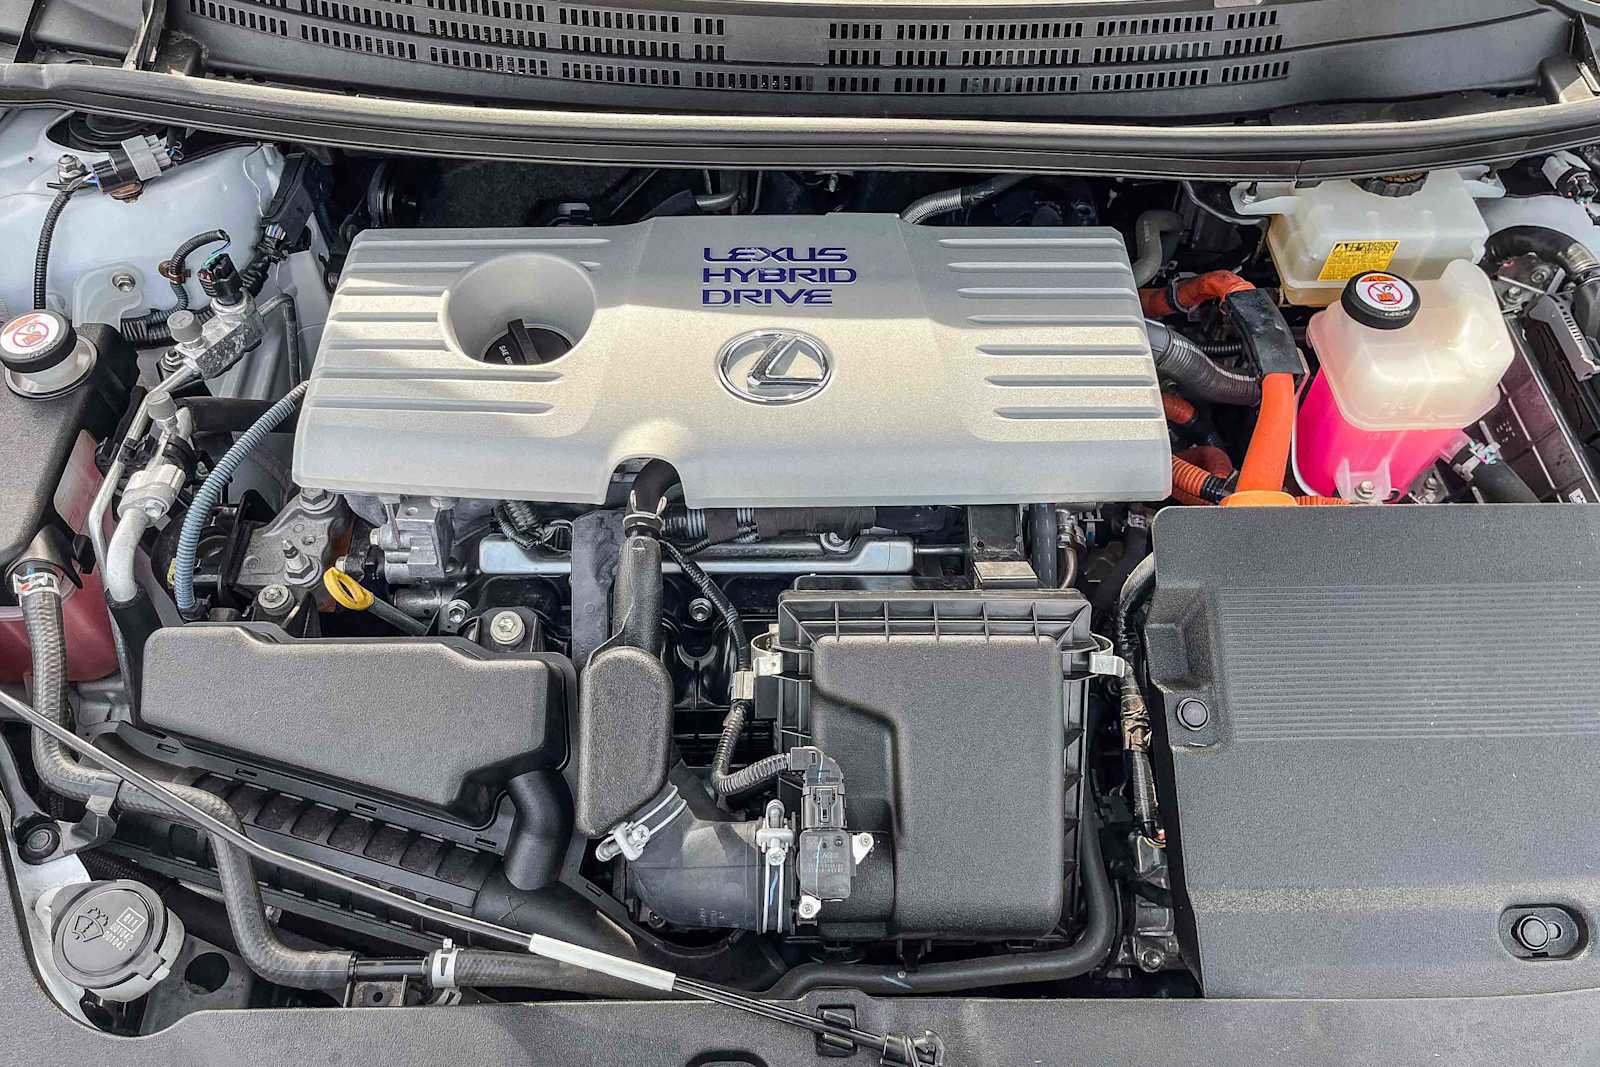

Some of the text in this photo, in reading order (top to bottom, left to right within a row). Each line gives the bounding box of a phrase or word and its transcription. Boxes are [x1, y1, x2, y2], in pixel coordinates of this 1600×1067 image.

[703, 247, 848, 263] LEXUS
[703, 267, 857, 284] HYBRID
[702, 288, 833, 305] DRIVE
[499, 345, 509, 357] SAE
